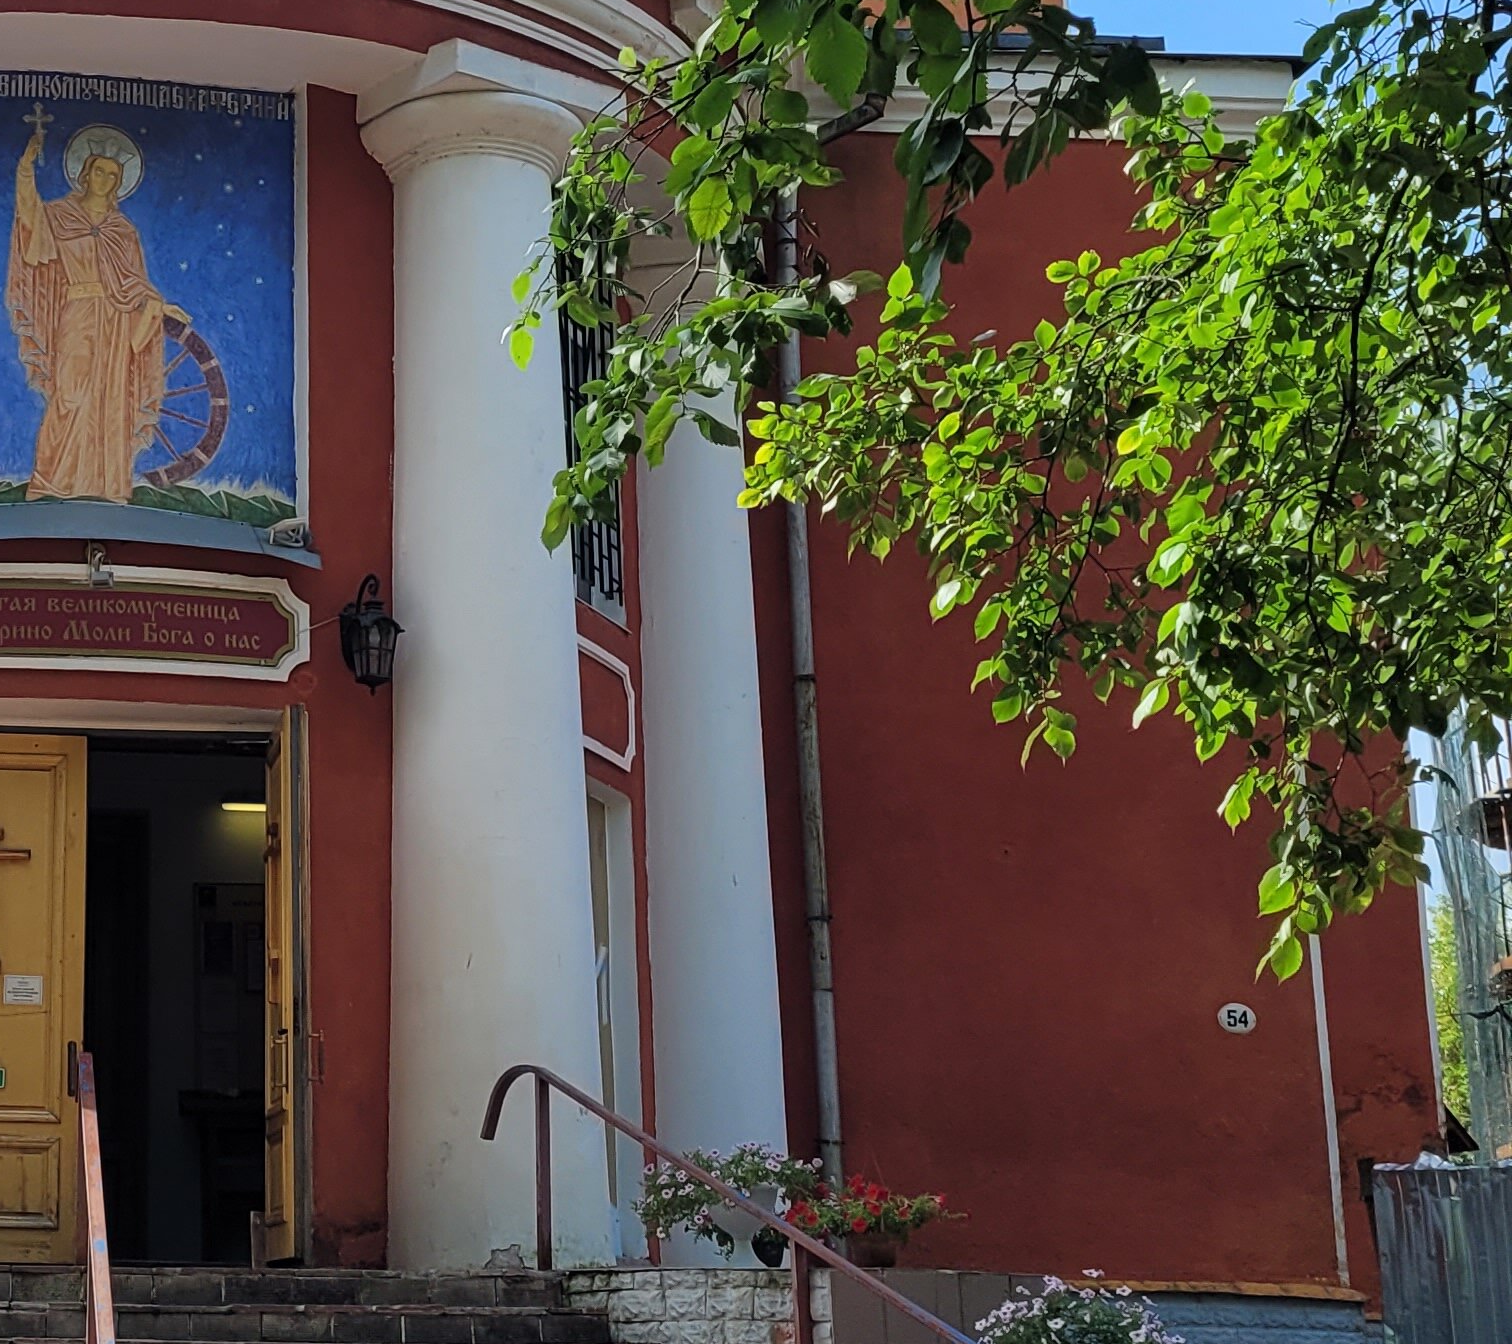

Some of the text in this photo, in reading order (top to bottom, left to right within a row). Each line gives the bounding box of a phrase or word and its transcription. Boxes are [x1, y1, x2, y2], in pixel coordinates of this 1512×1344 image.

[47, 597, 241, 622] великомученица
[63, 621, 131, 643] Моли
[142, 622, 194, 647] Бога
[204, 632, 215, 647] о
[225, 633, 261, 651] нас
[1226, 1009, 1249, 1028] 54
